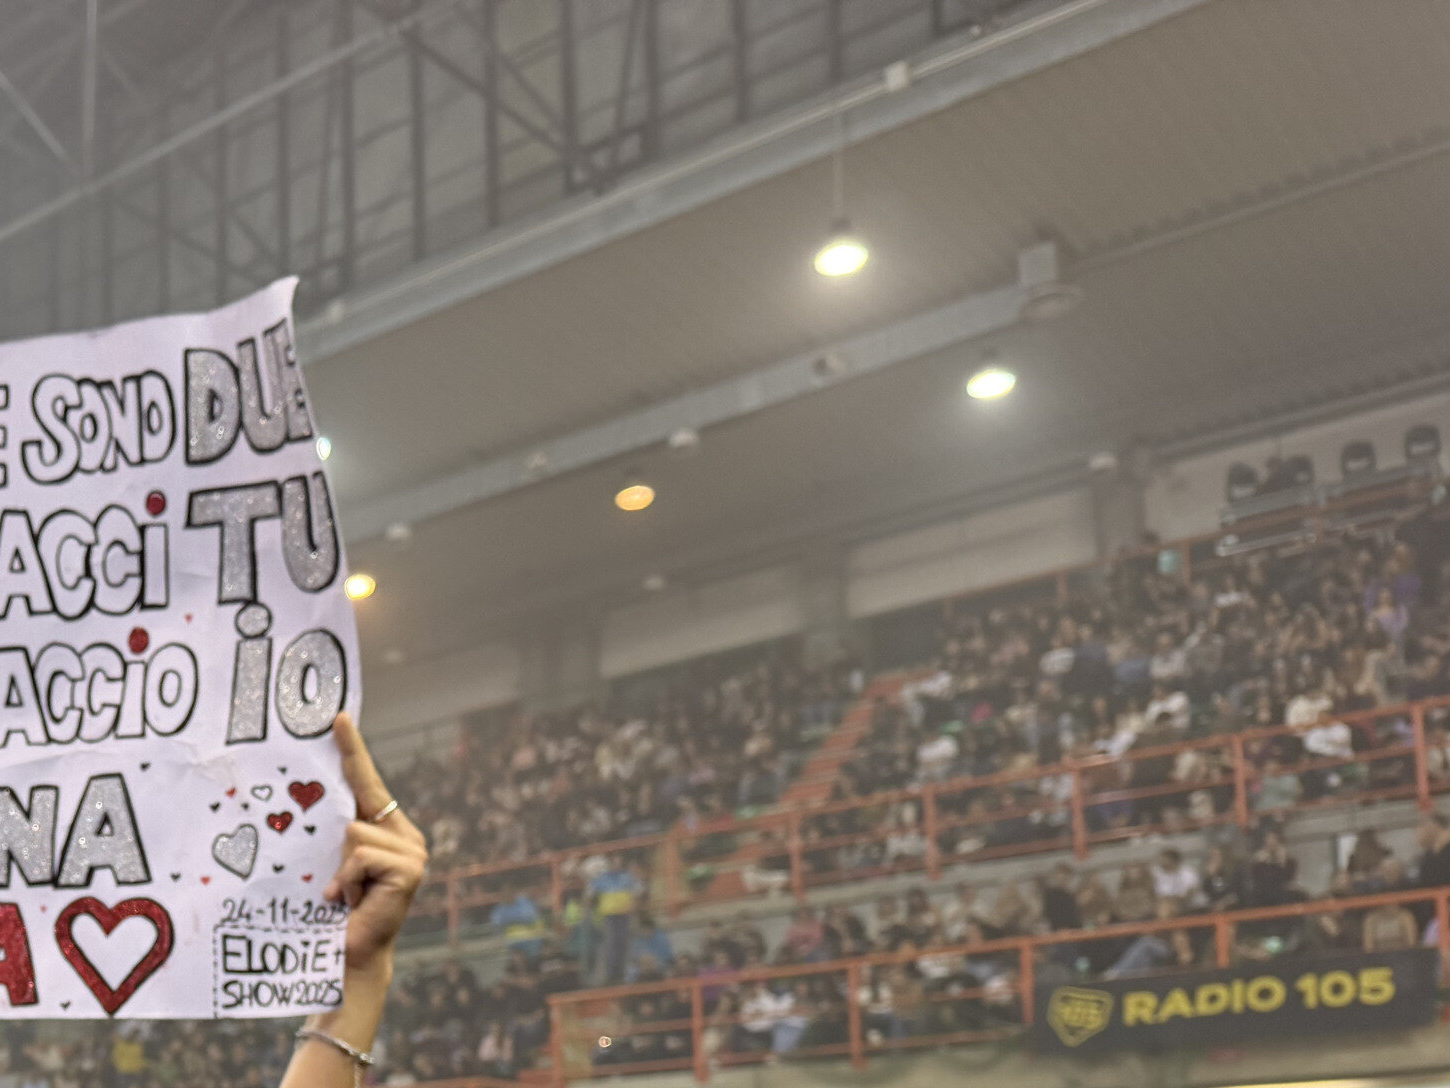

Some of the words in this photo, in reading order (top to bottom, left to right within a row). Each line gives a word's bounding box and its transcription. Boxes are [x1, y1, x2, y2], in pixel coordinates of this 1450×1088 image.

[185, 471, 340, 604] TU
[1122, 975, 1287, 1027] RADIO
[1295, 966, 1395, 1009] 105
